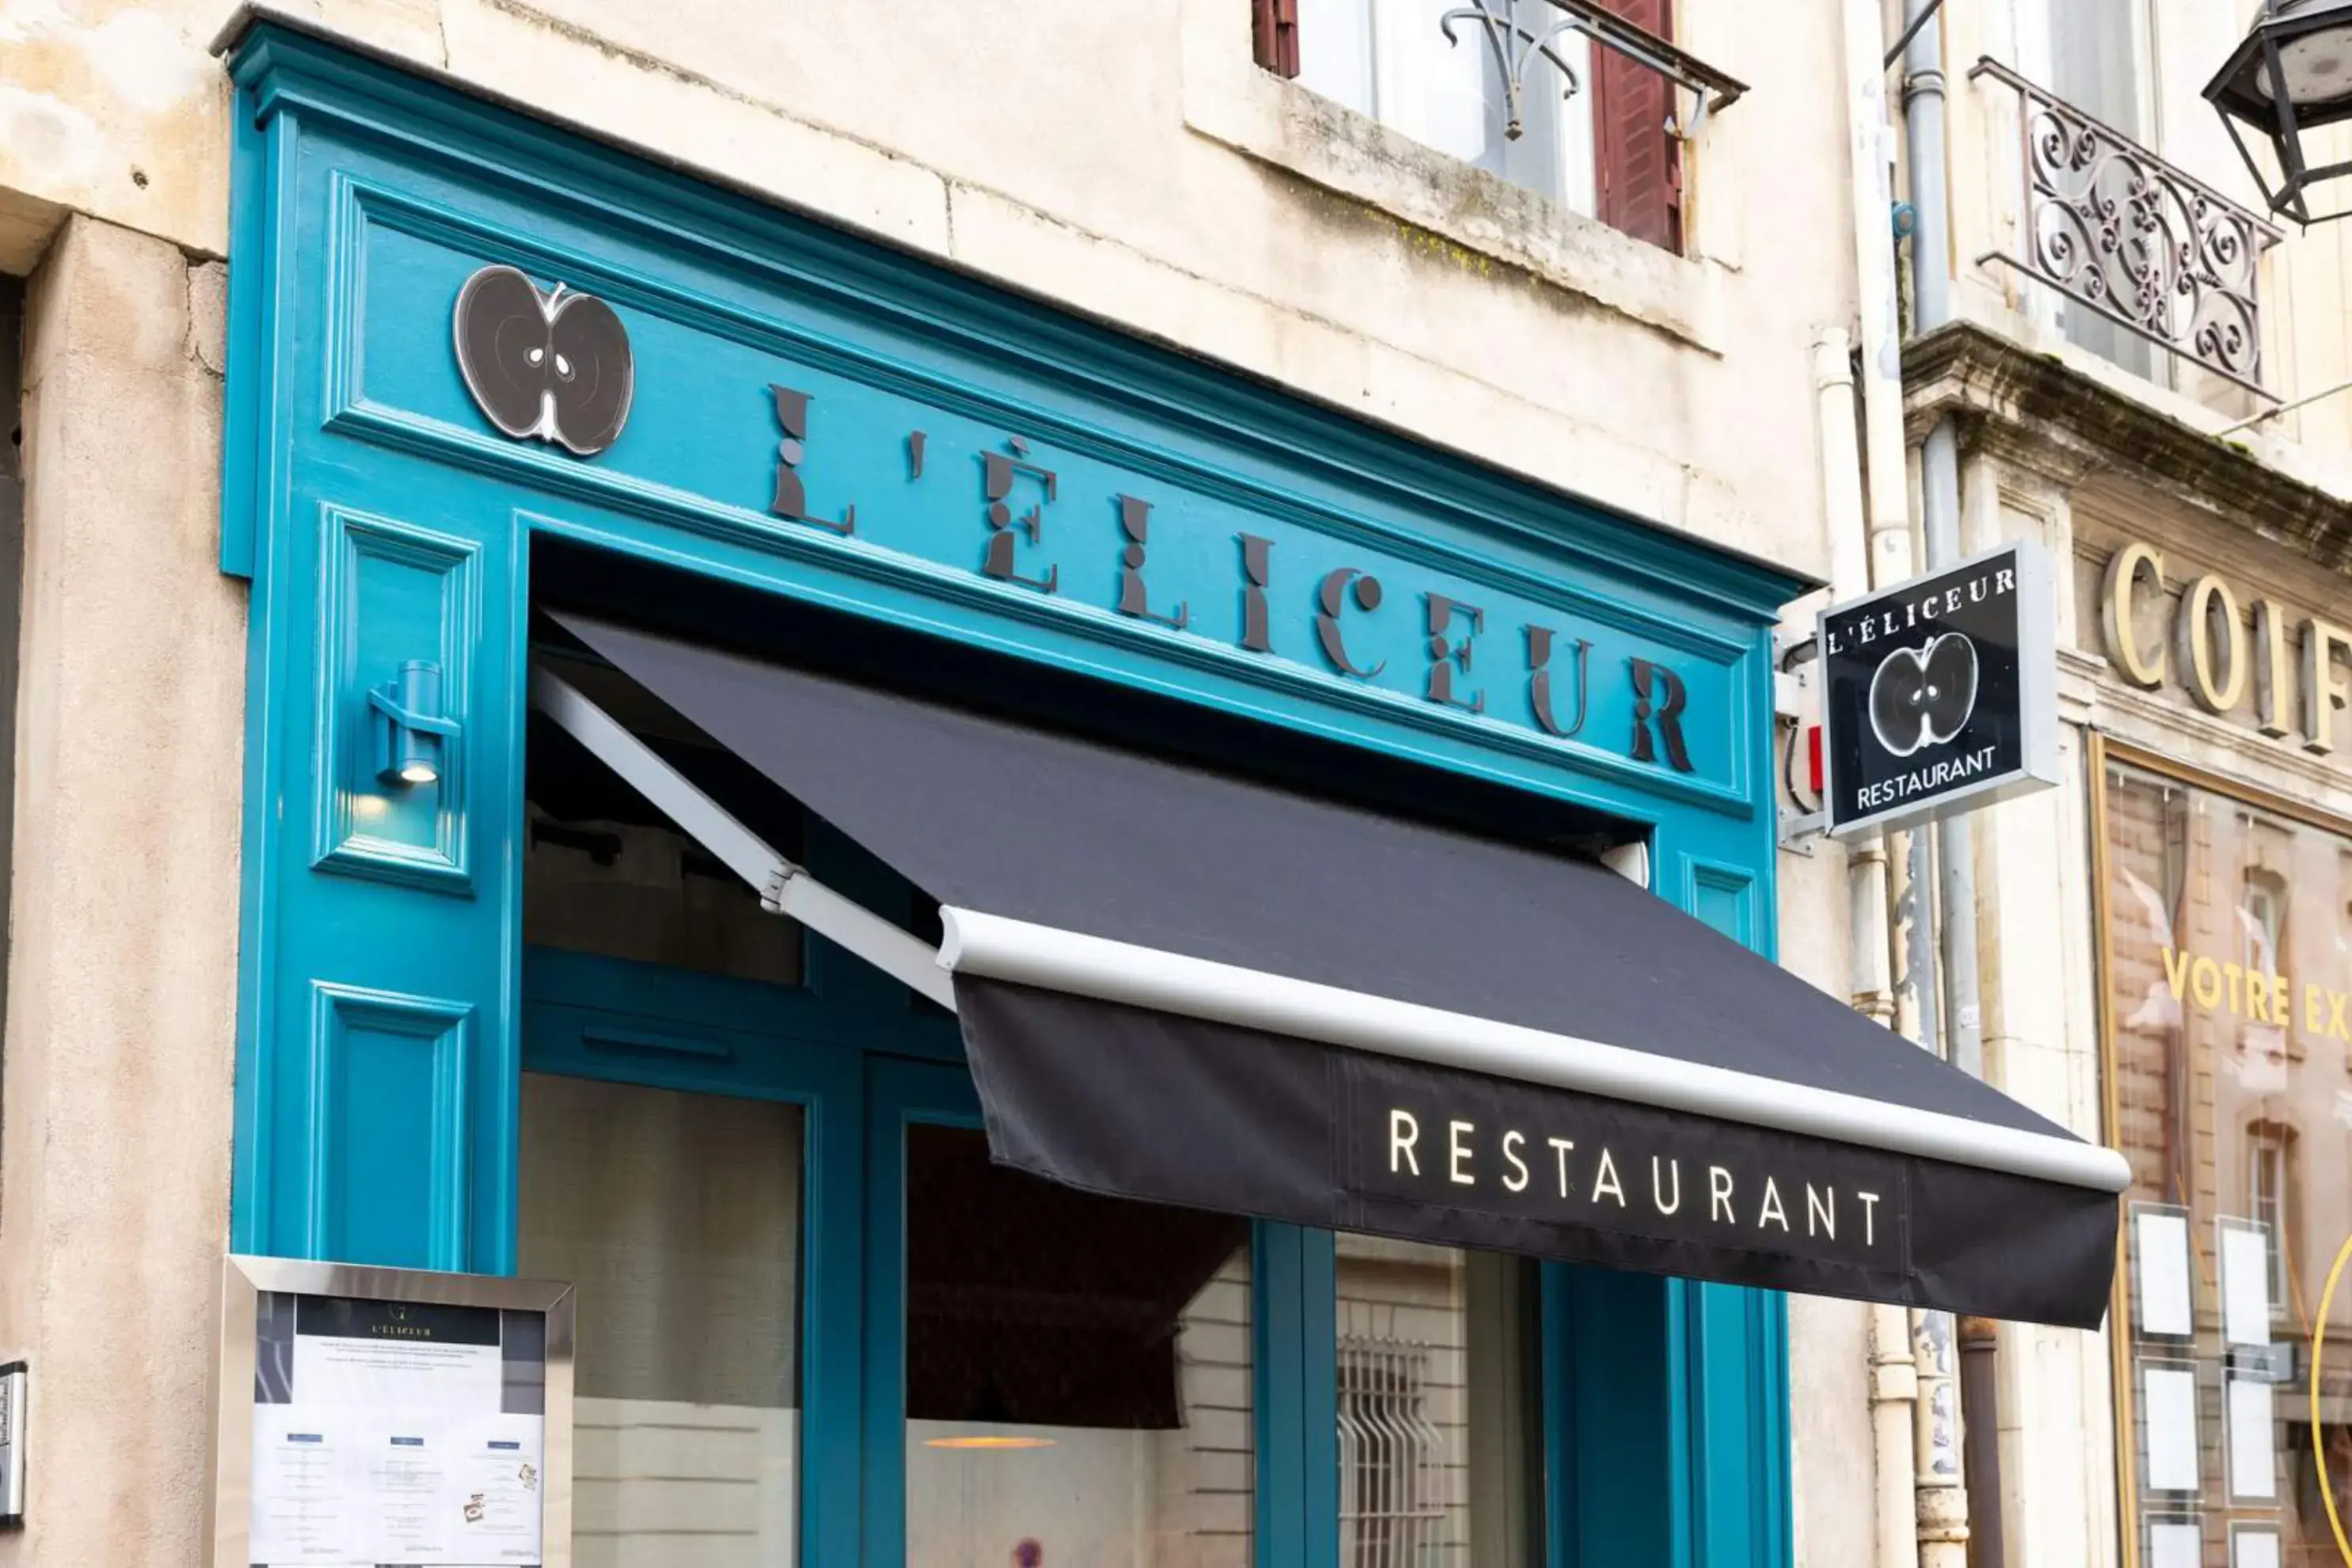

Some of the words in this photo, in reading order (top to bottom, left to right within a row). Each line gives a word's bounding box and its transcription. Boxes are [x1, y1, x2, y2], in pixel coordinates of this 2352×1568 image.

[1827, 567, 2016, 655] L'ÉLICEUR
[1857, 746, 1996, 810] RESTAURANT
[2162, 947, 2290, 1026] VOTRE
[1389, 1109, 1880, 1246] RESTAURANT
